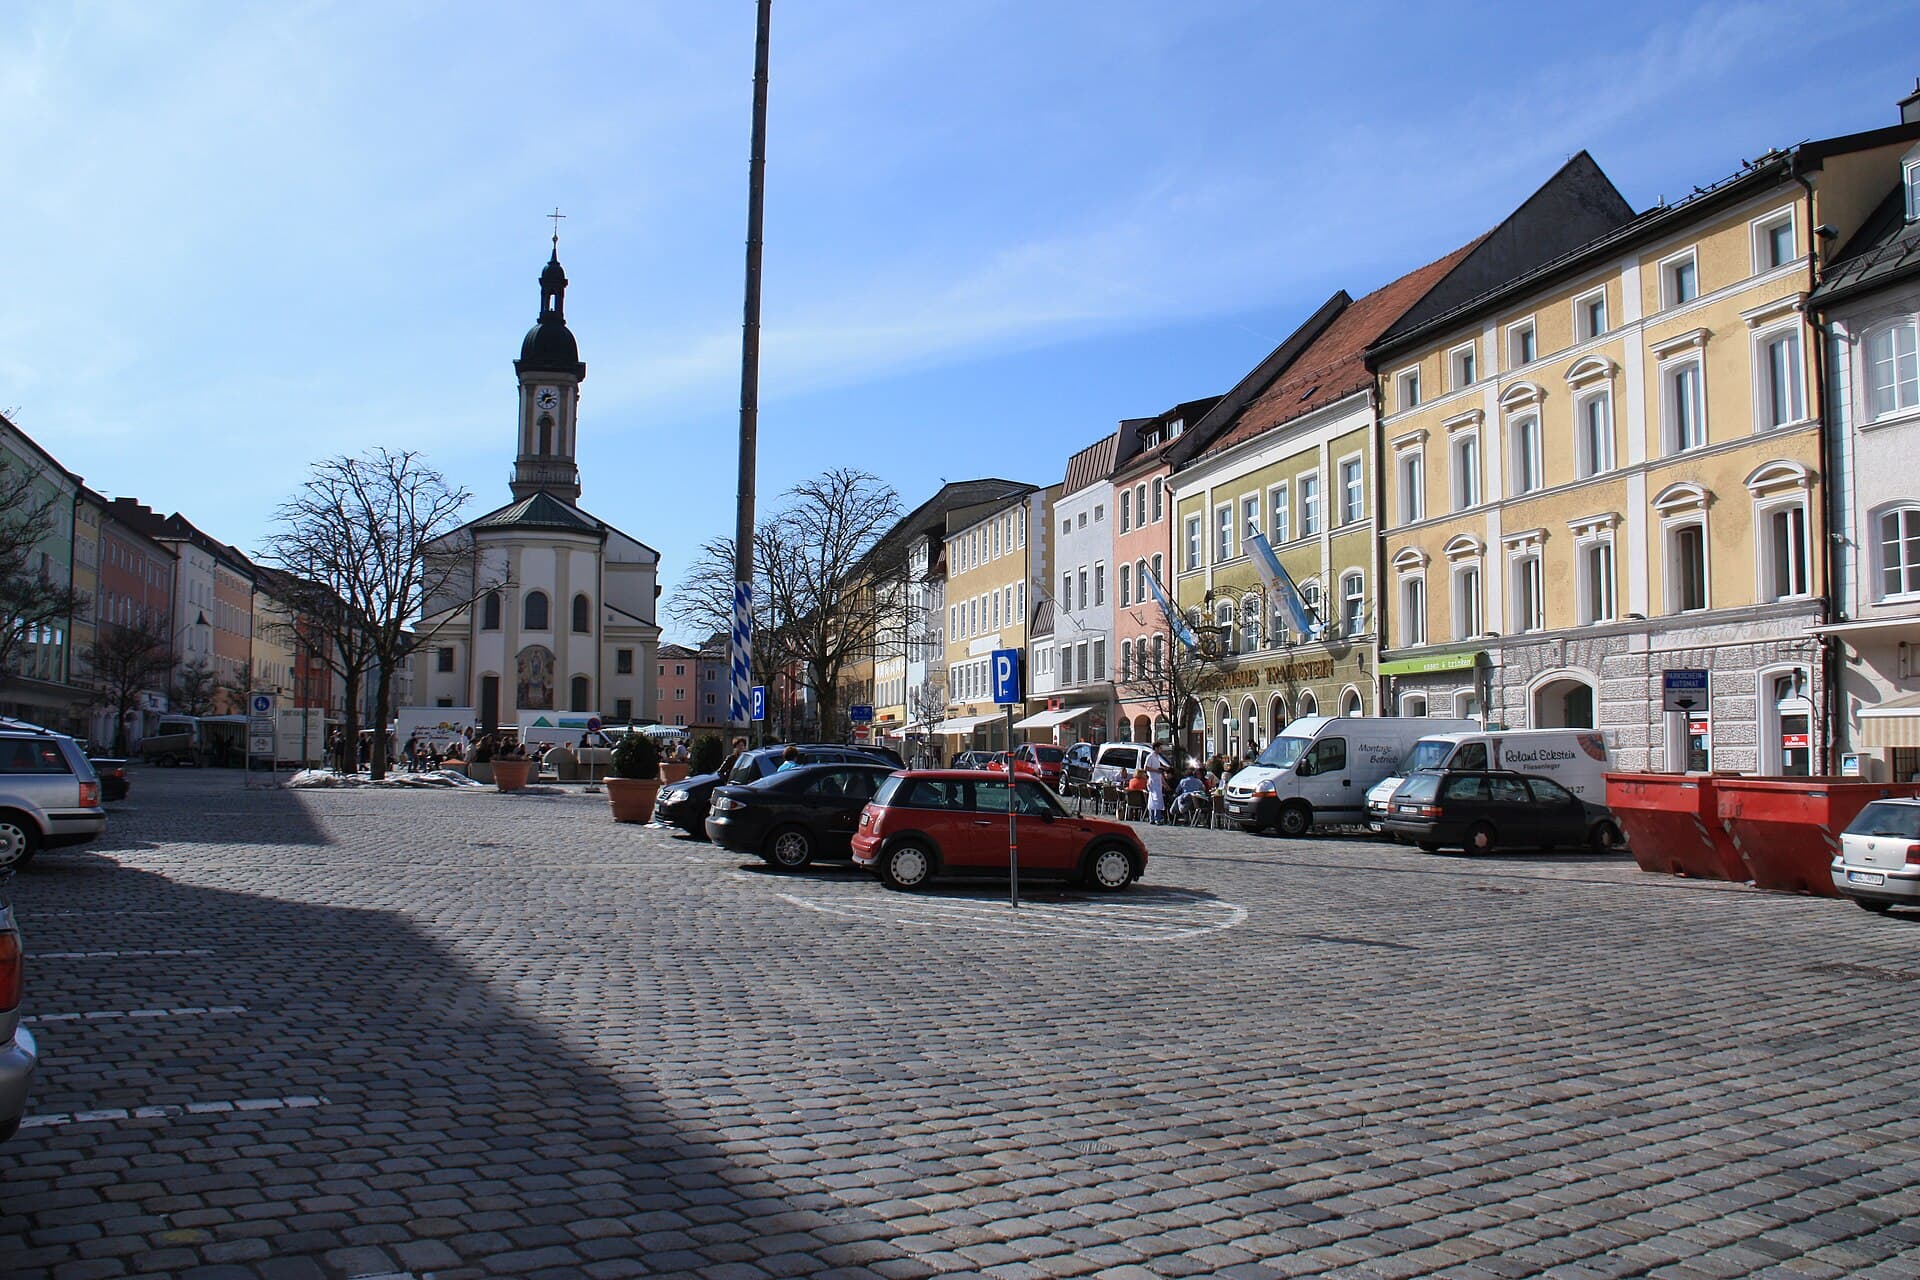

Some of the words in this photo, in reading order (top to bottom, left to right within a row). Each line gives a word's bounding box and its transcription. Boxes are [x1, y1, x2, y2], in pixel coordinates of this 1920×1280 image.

[997, 656, 1011, 697] P
[1264, 658, 1335, 685] TRAUNSTEIN
[754, 691, 762, 716] P
[1358, 744, 1392, 755] Montage
[1505, 750, 1537, 762] Roland
[1539, 749, 1577, 760] Eckstein
